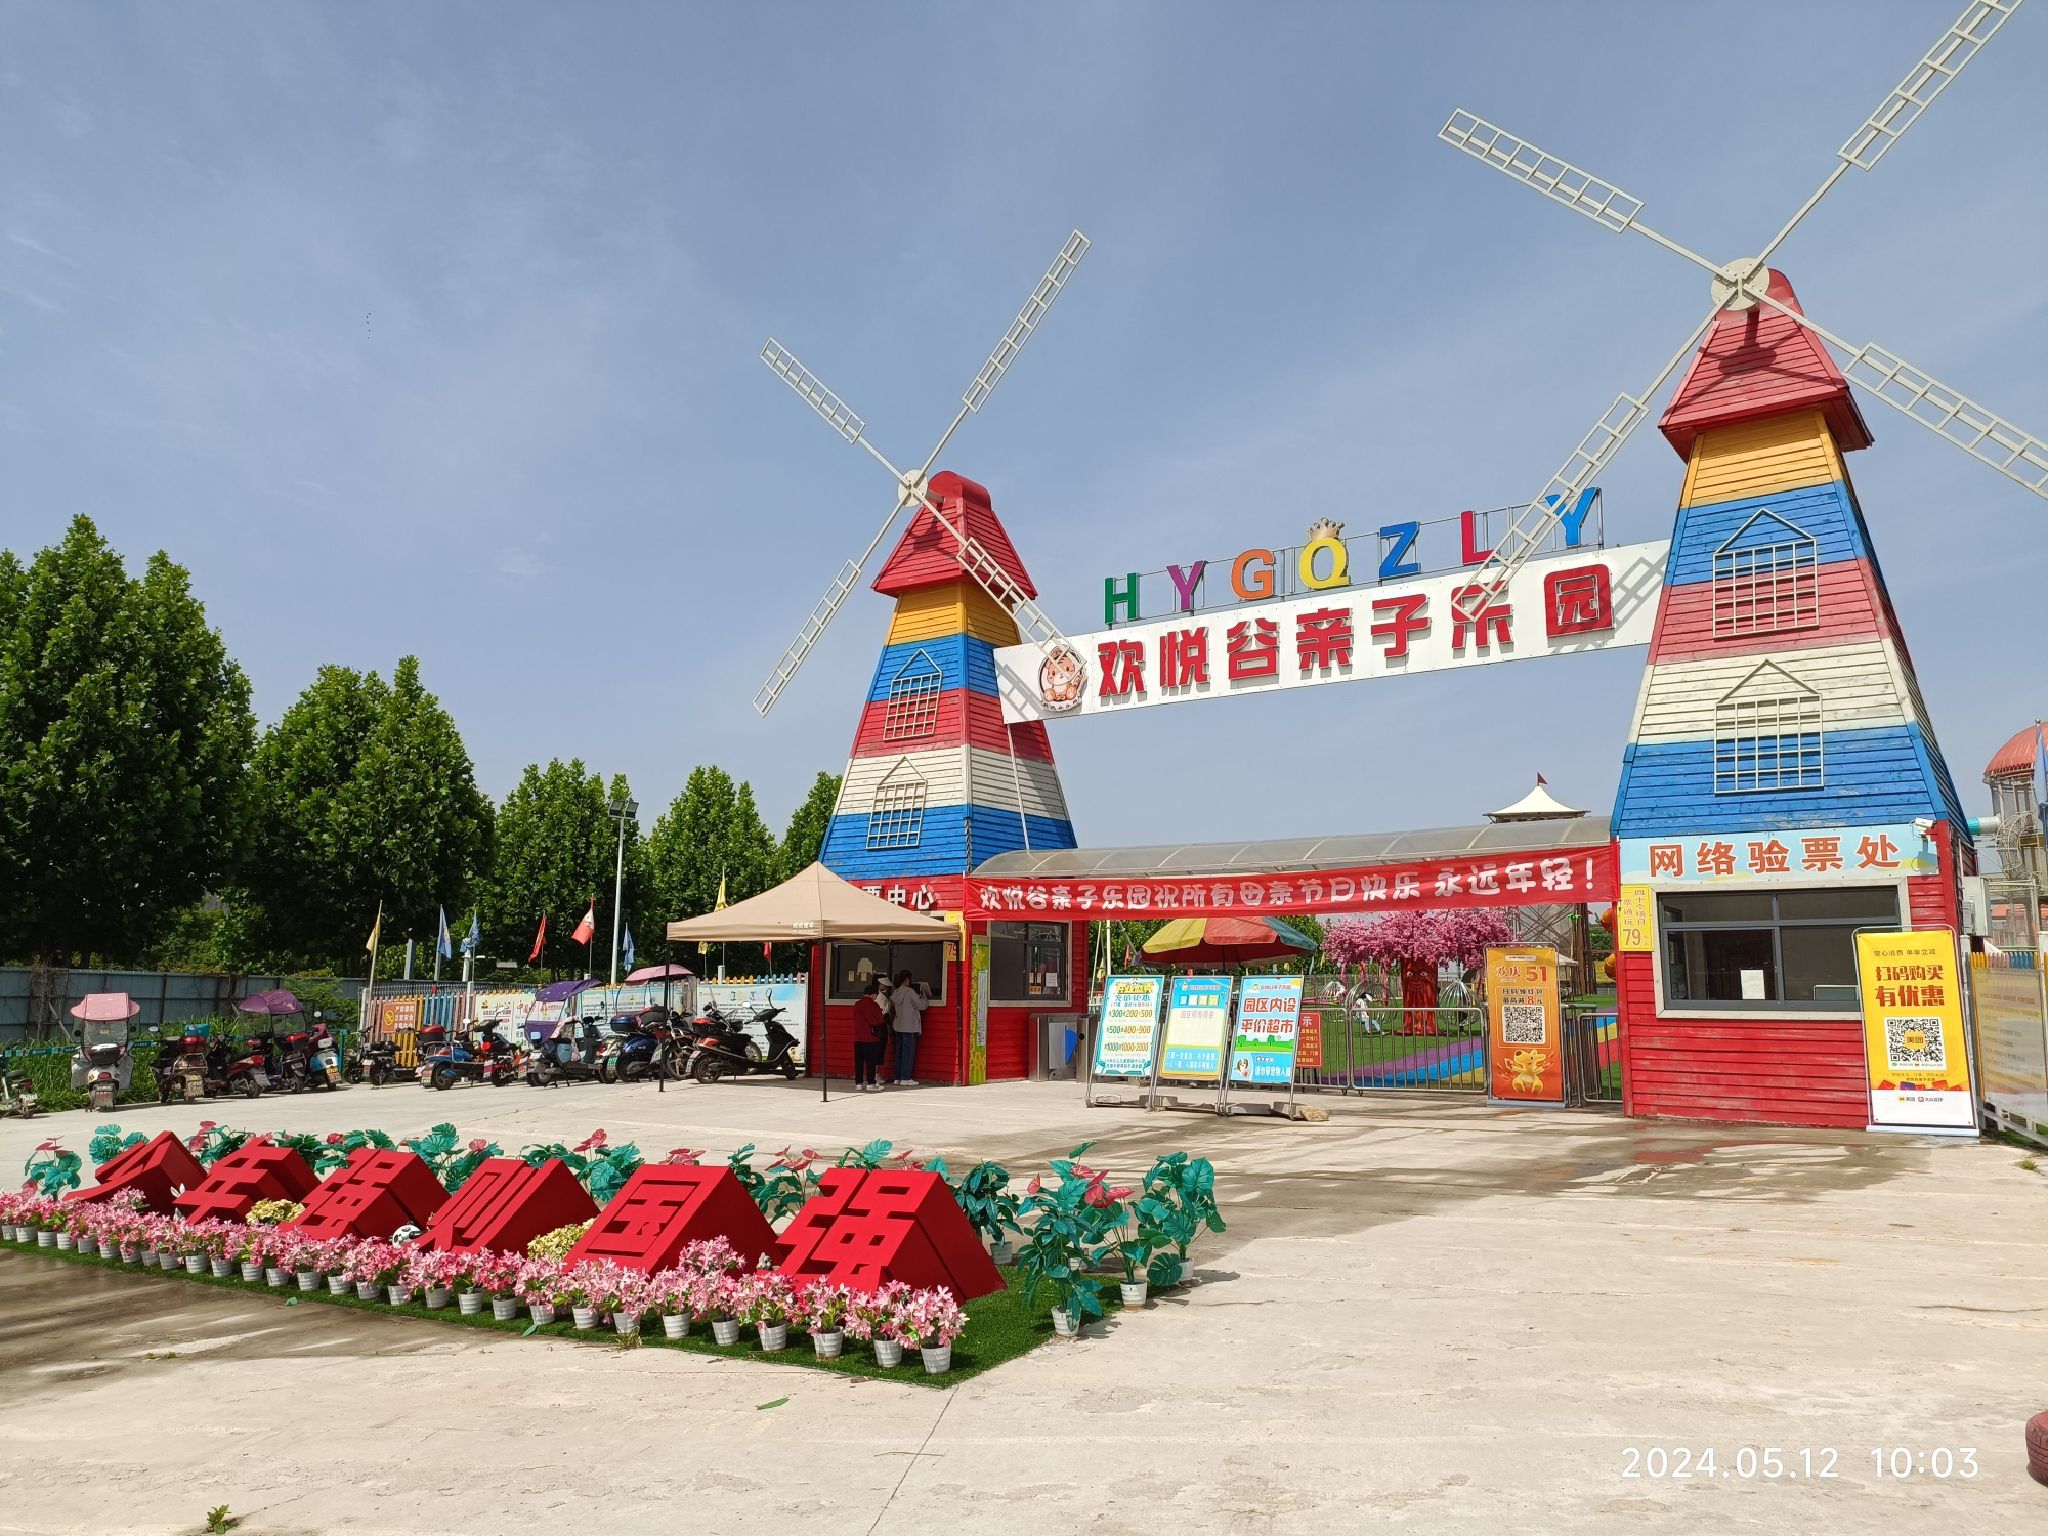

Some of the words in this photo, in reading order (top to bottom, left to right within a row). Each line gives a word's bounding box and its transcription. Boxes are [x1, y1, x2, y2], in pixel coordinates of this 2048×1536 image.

[1098, 564, 1615, 698] 欢悦谷亲子乐园
[1649, 834, 1901, 878] 网络验票处
[979, 871, 1421, 911] 欢悦谷亲子乐园祝所有母亲节日快乐
[1622, 928, 1642, 946] 79
[1525, 965, 1548, 982] 51
[1875, 965, 1944, 981] 扫码购买
[1243, 997, 1297, 1013] 园区内设
[1874, 985, 1945, 1007] 有优惠
[1240, 1018, 1295, 1034] 平价超市
